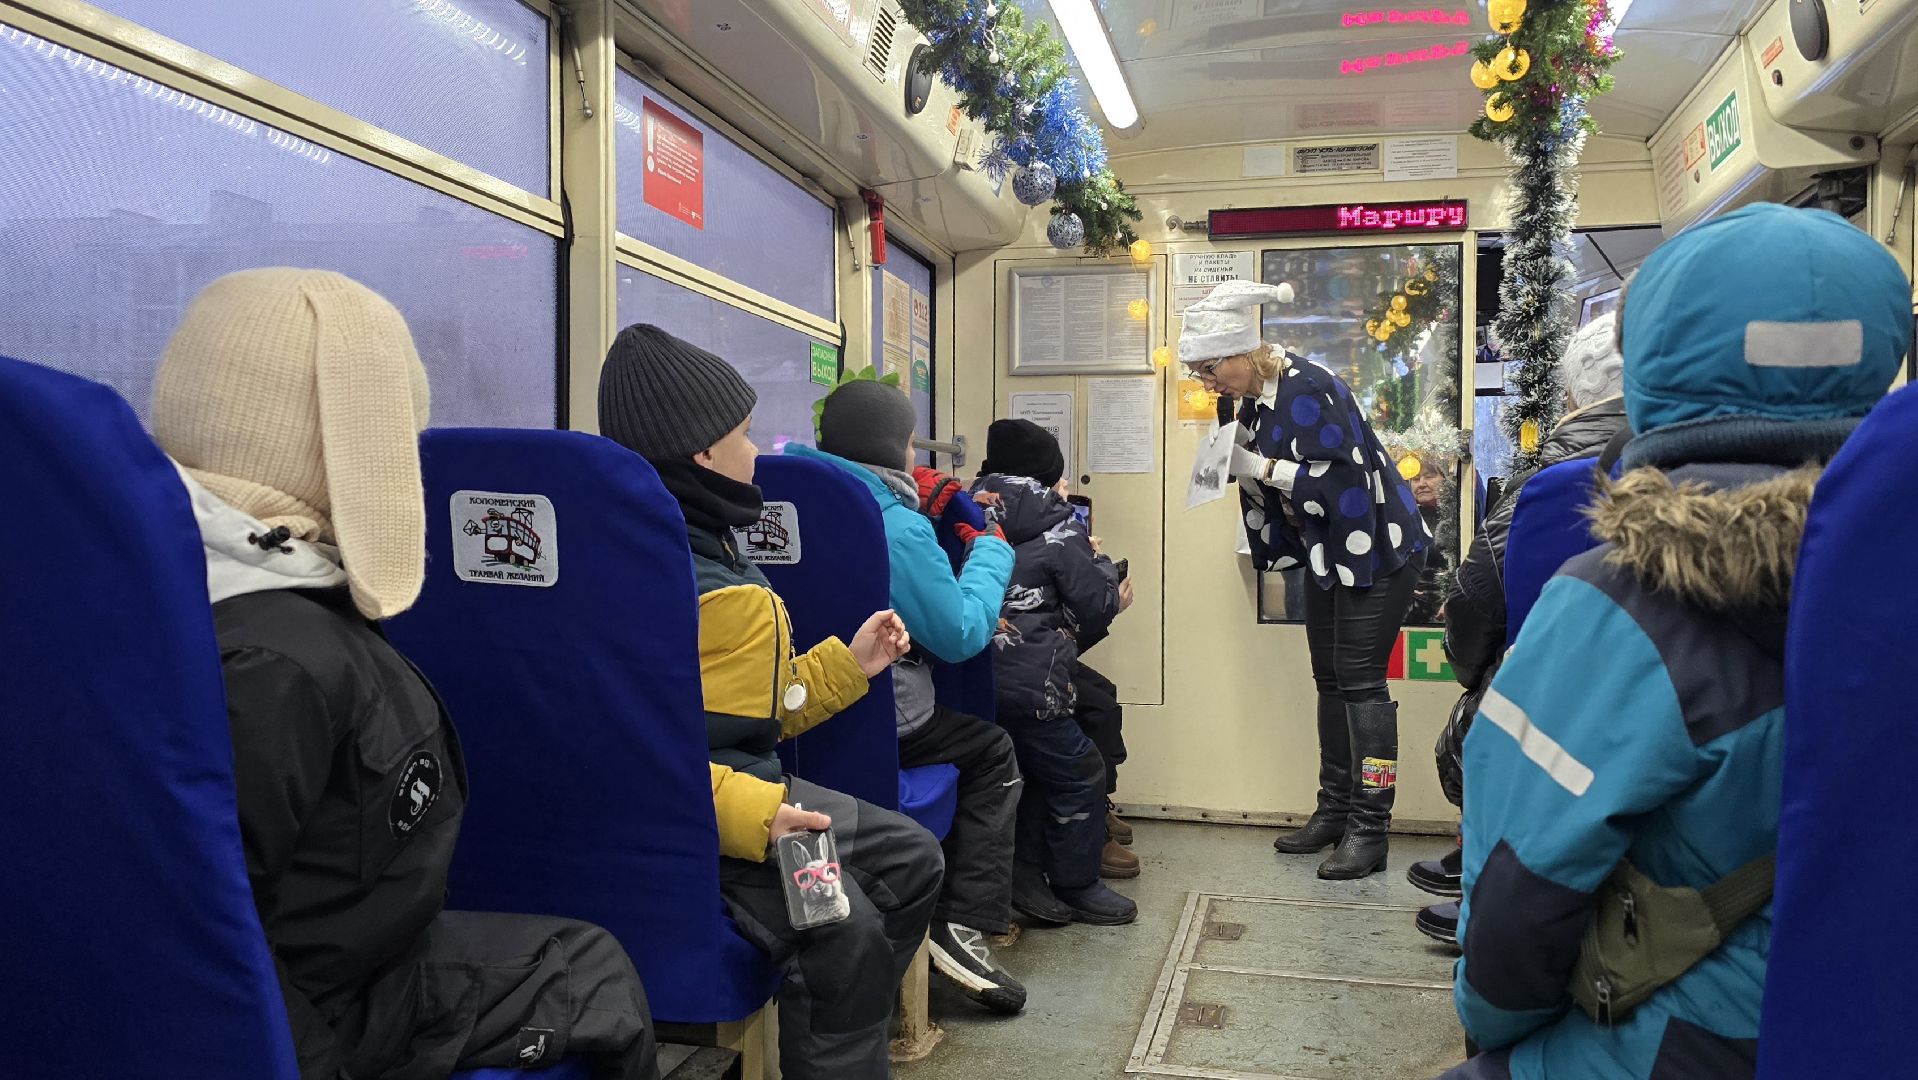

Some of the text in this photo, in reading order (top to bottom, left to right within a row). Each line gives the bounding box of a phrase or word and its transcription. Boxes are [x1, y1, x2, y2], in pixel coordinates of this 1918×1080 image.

[1708, 99, 1740, 163] ВЫХОД
[1340, 206, 1464, 228] Маршру
[1188, 275, 1198, 283] НЕ
[812, 361, 836, 381] ВЫХОД
[469, 497, 536, 508] КОЛОМЕНСКИЙ
[468, 569, 545, 582] ТРАМВАЙ ЖЕЛАНИЙ
